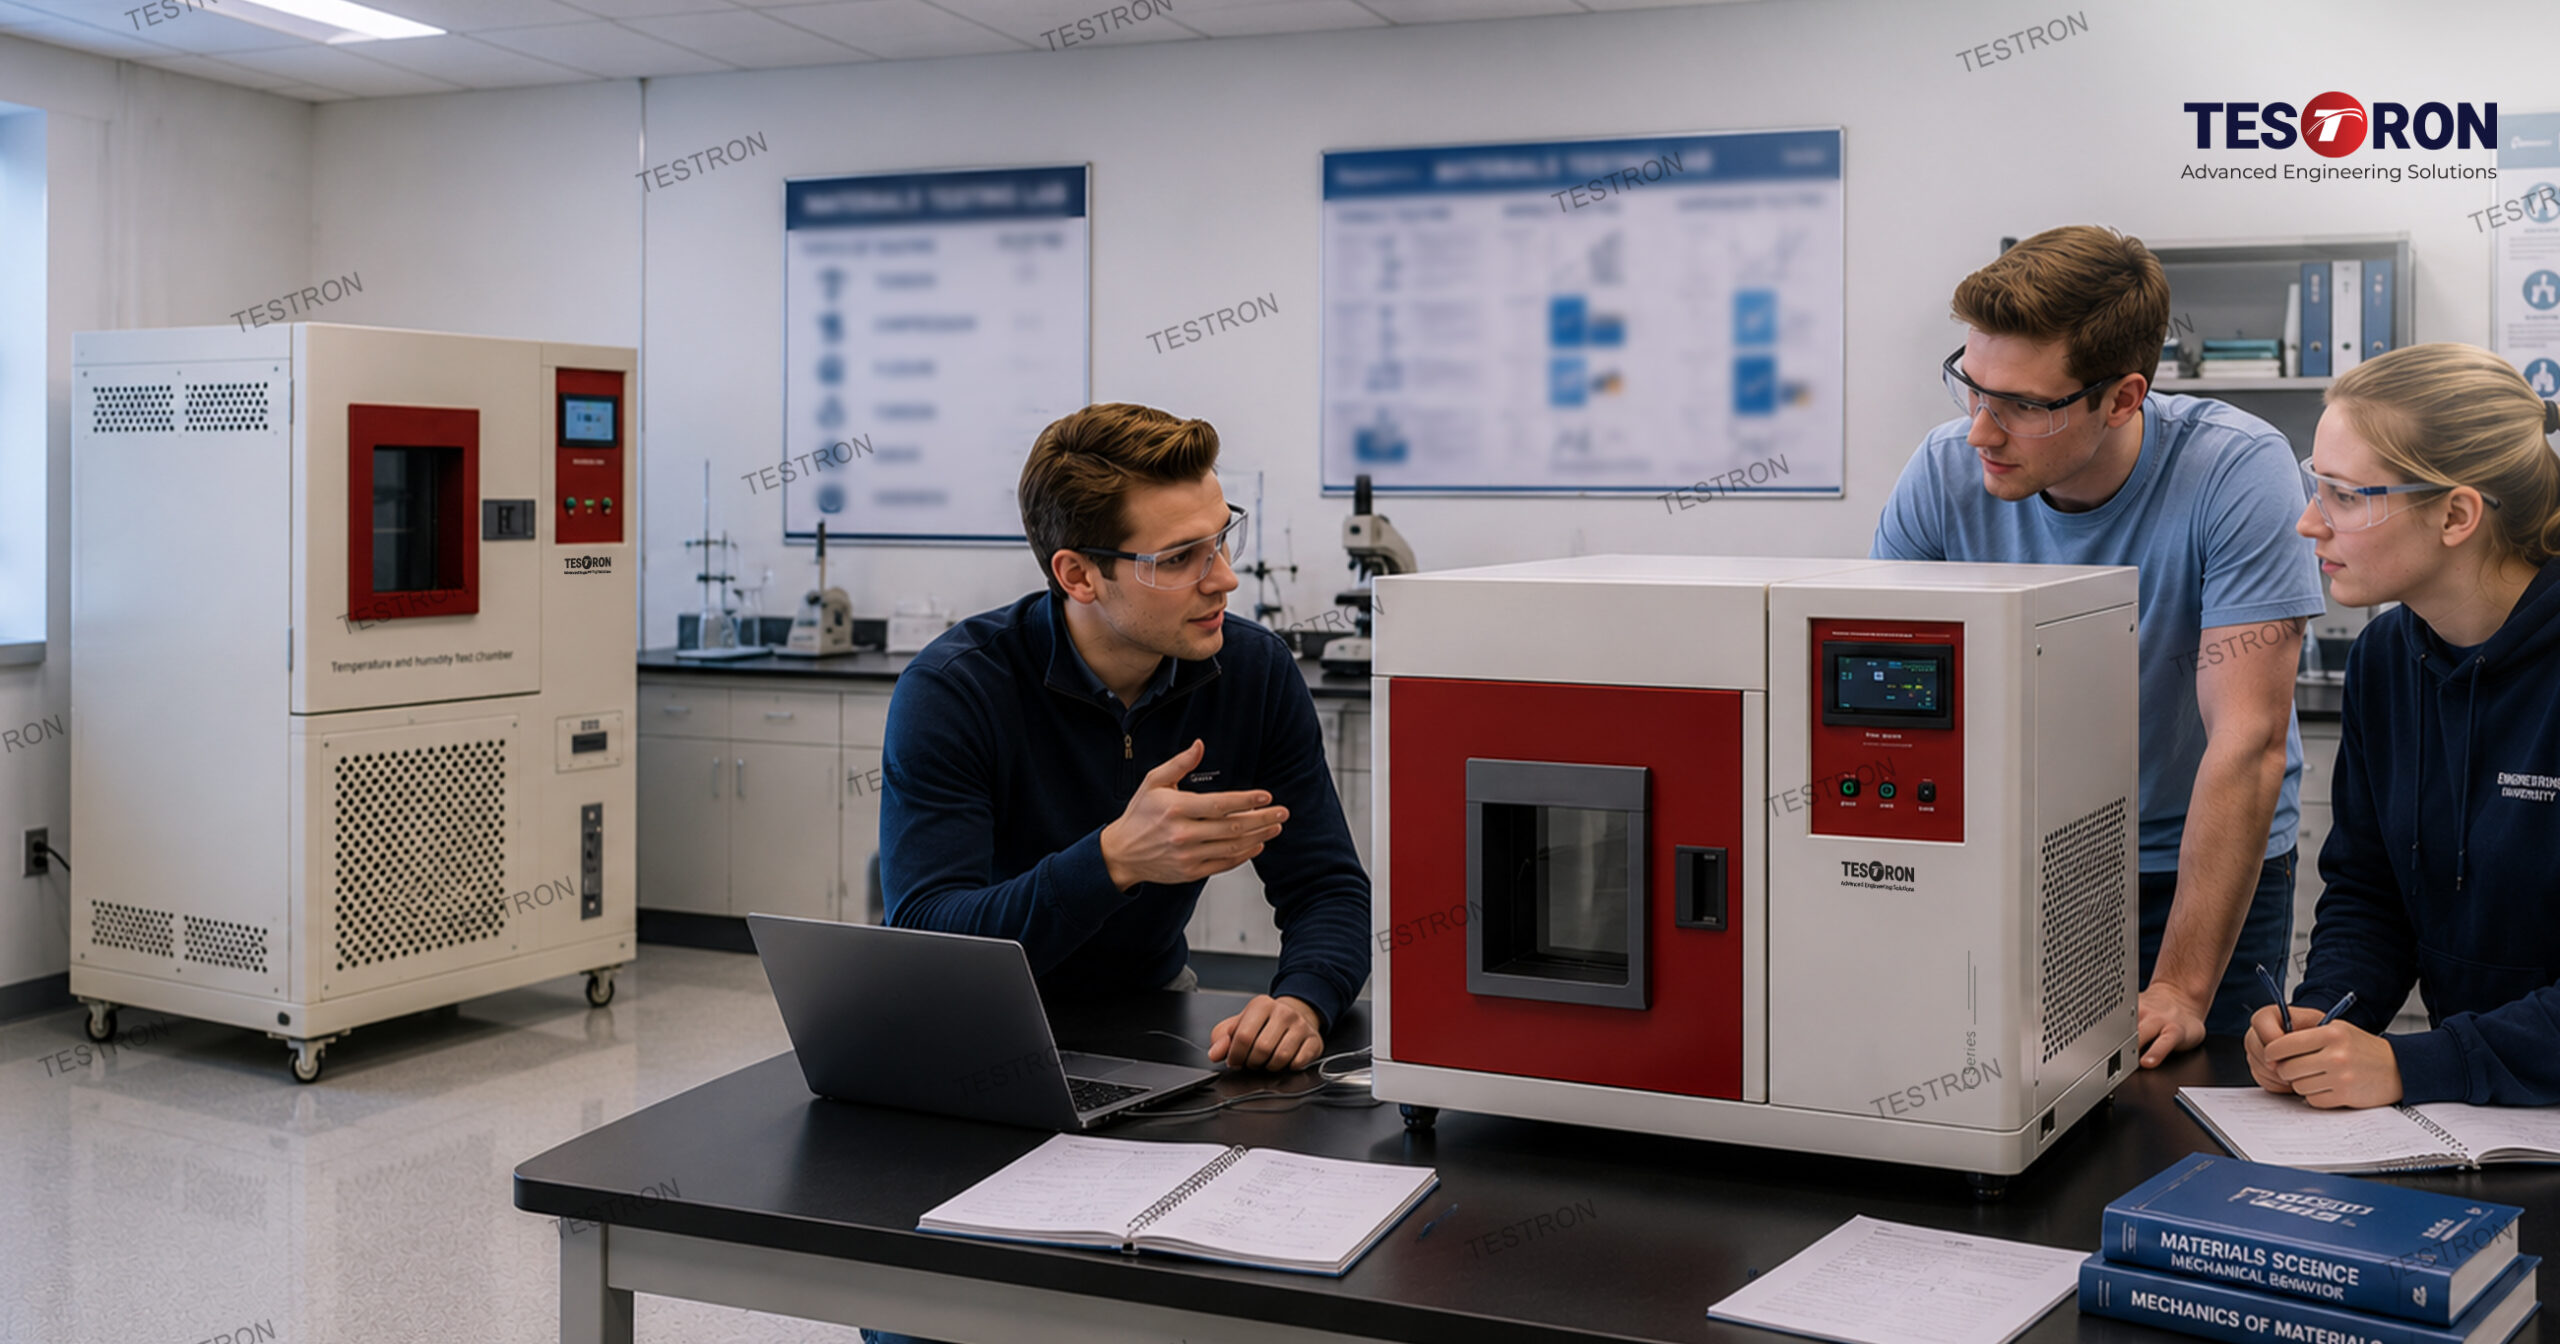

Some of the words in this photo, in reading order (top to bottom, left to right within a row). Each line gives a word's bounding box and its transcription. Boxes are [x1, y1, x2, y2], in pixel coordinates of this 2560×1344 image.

[331, 660, 392, 674] Temperature
[395, 656, 413, 668] and
[1841, 860, 1915, 882] TESTRON
[2160, 1231, 2267, 1267] MATERIALS
[2171, 1253, 2266, 1285] MECHANICAL
[2131, 1290, 2240, 1328] MECHANICS
[2244, 1314, 2270, 1334] OF
[2274, 1320, 2383, 1344] MATERI
